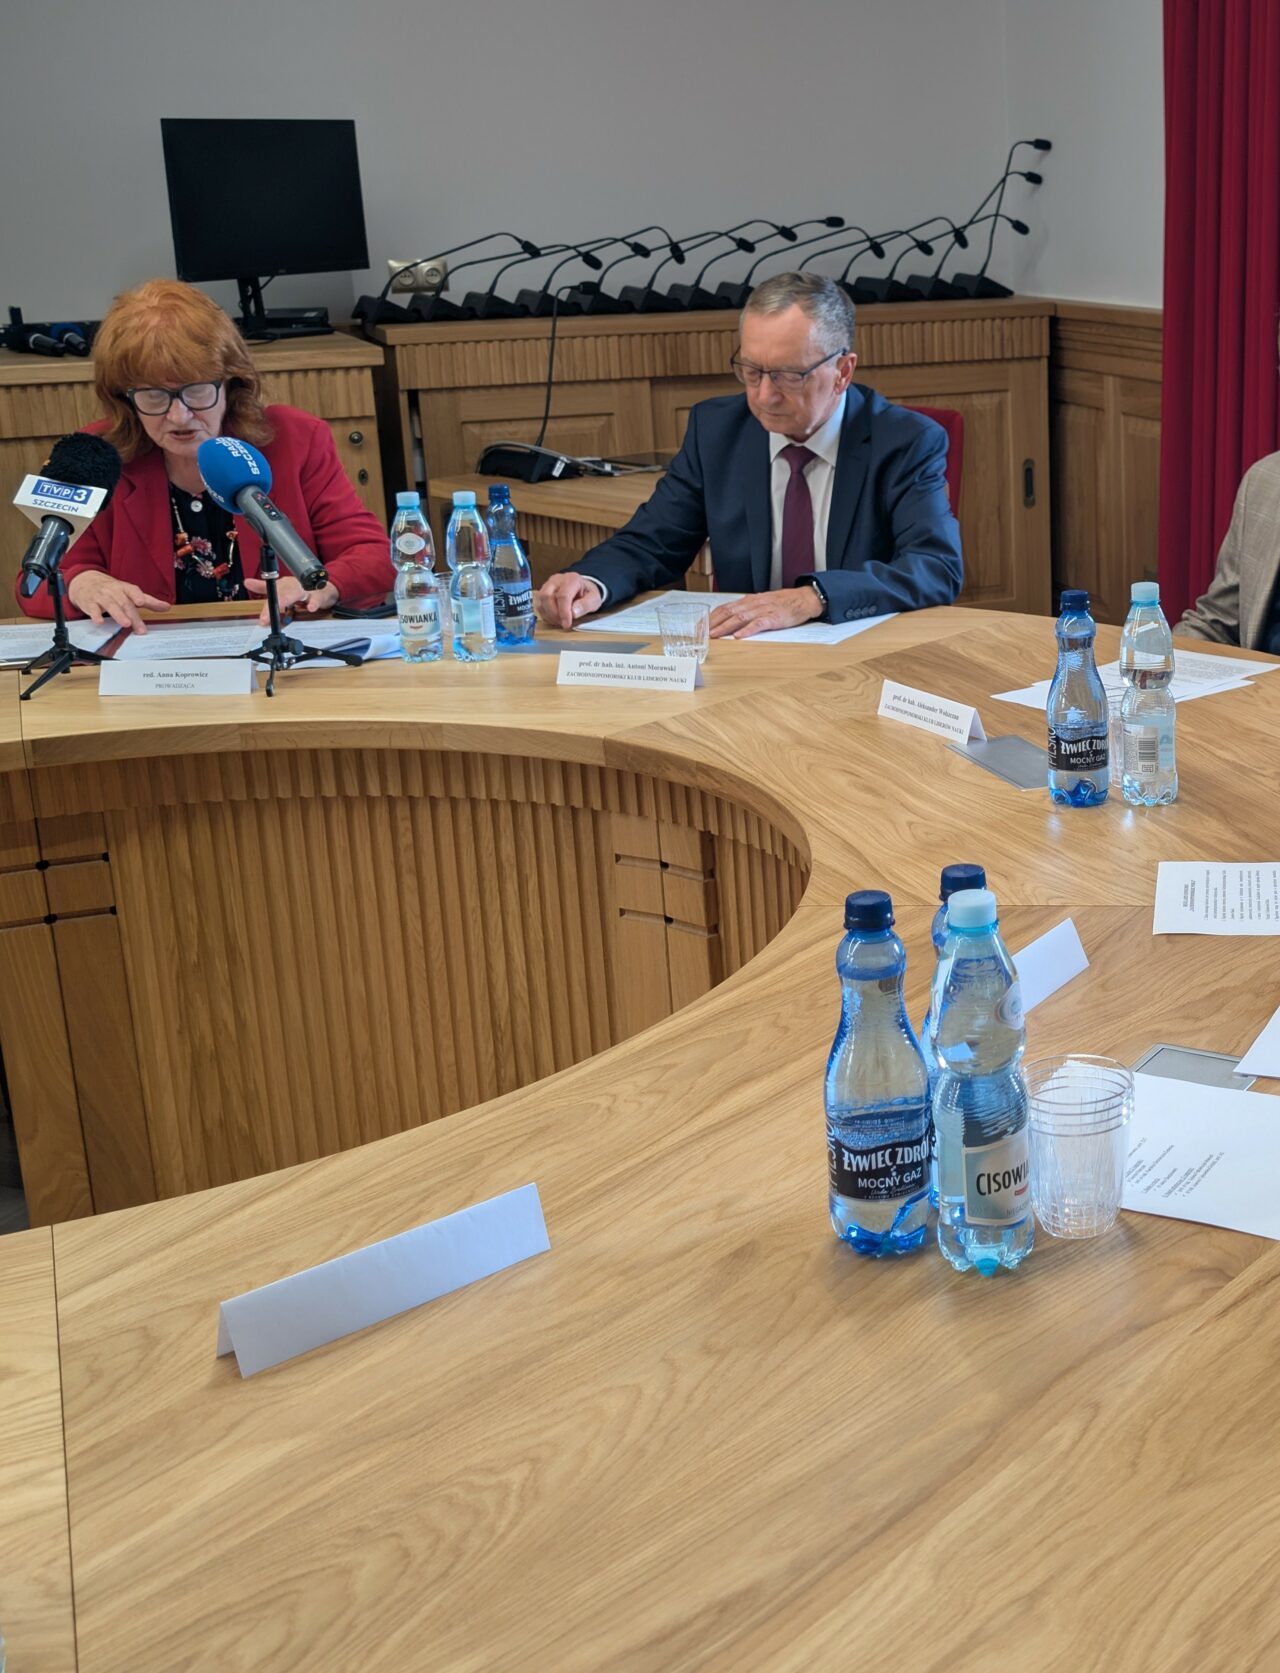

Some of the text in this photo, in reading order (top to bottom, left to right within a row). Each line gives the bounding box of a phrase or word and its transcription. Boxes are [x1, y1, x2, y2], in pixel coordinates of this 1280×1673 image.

[39, 482, 88, 502] TVP3
[32, 498, 79, 513] SZCZECIN
[175, 671, 208, 680] Koprowicz
[1060, 740, 1091, 755] ŻYWIEC
[1069, 756, 1096, 765] MOCNY
[841, 1147, 893, 1172] ŻYWIEC
[858, 1166, 922, 1189] MOCNY GAZ
